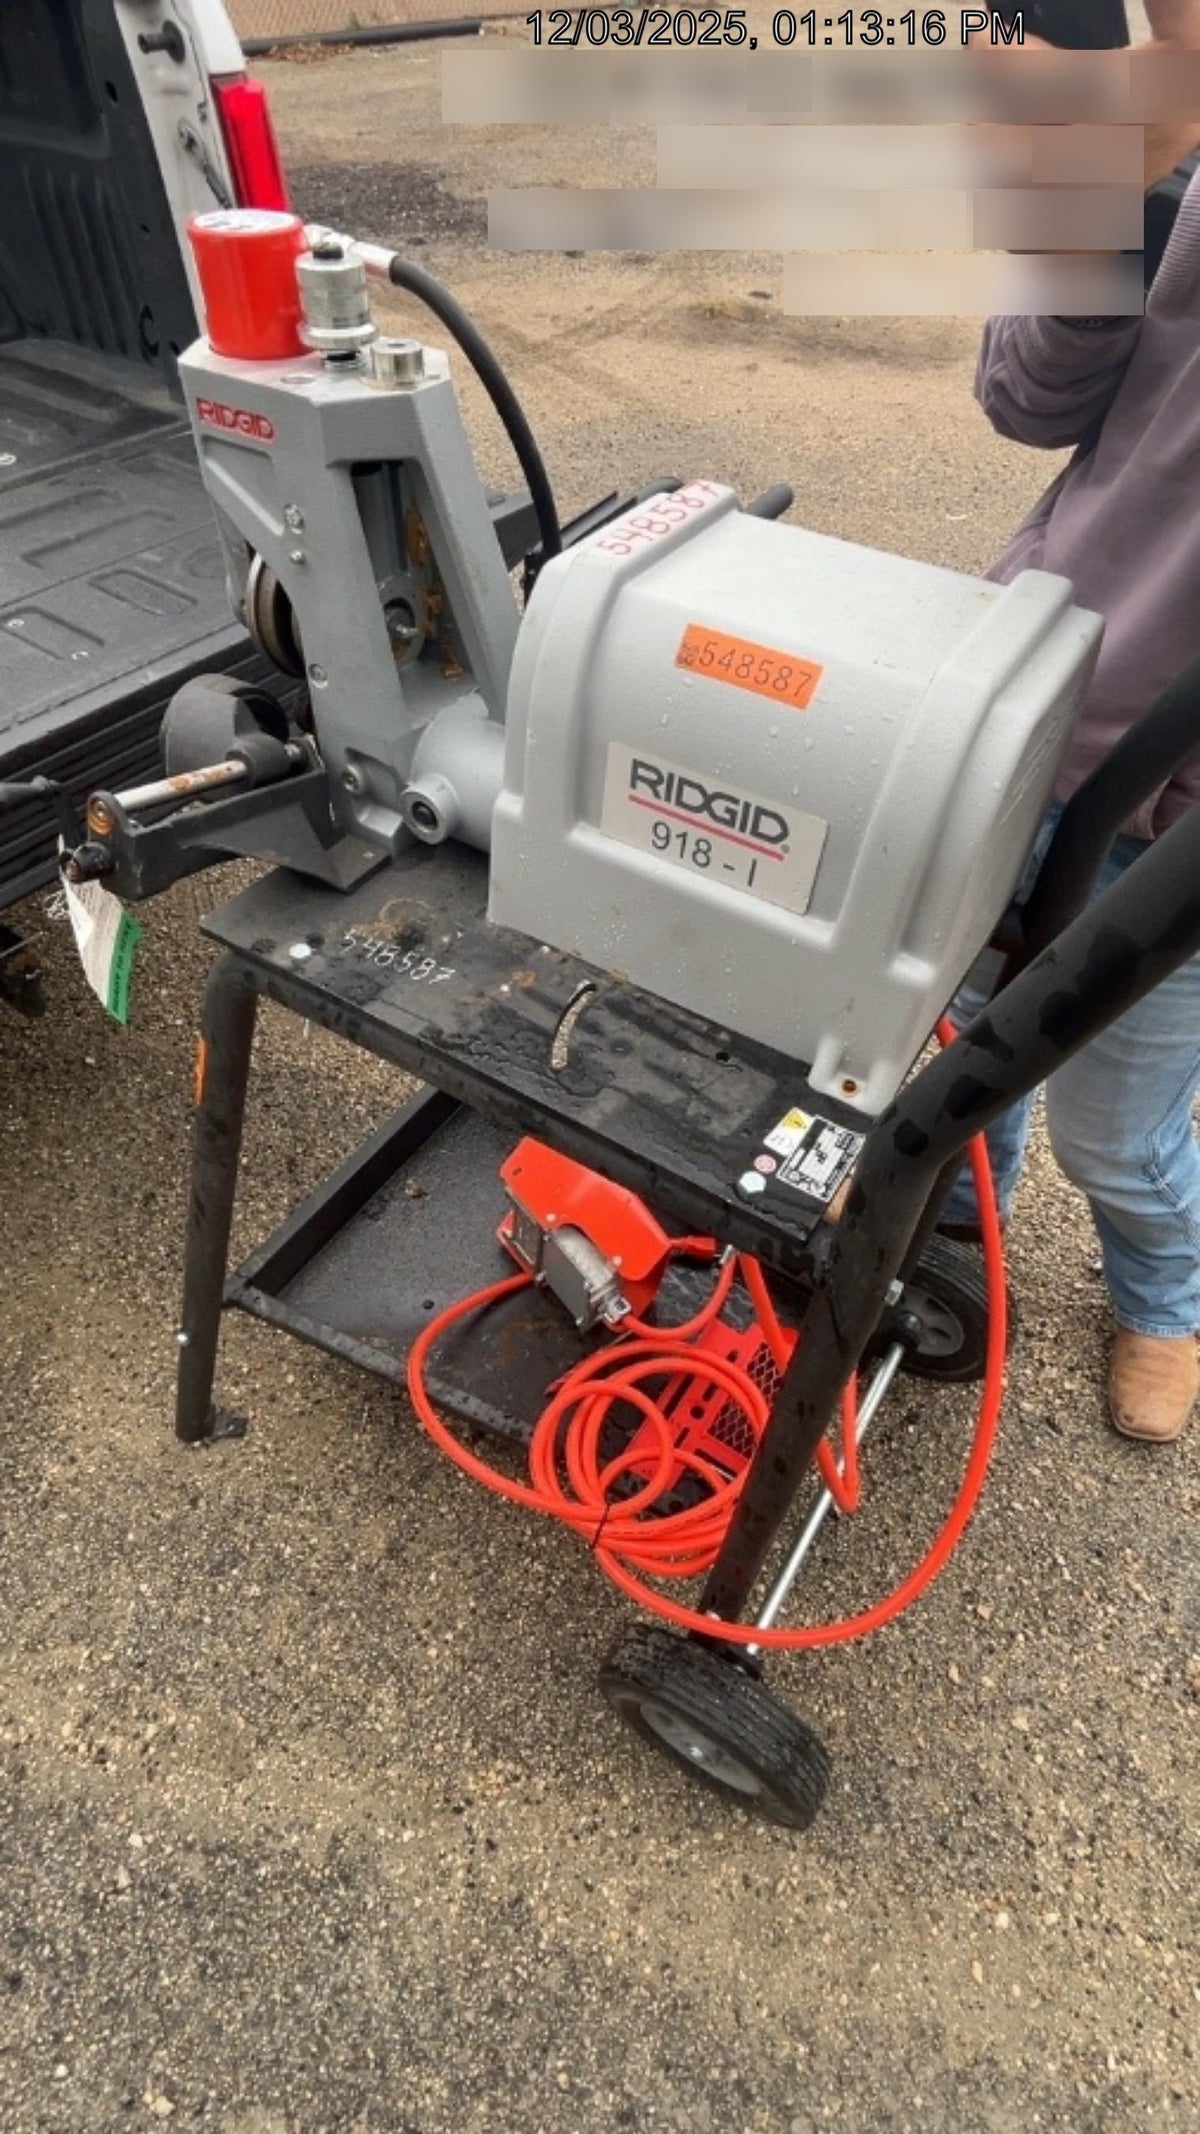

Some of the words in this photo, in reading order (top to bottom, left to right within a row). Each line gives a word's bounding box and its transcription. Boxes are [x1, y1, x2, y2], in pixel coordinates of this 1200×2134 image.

[196, 398, 276, 440] RIDGID
[596, 480, 720, 556] 548587
[699, 640, 813, 698] 548587
[629, 757, 790, 845] RIDGID
[341, 927, 457, 985] 548587
